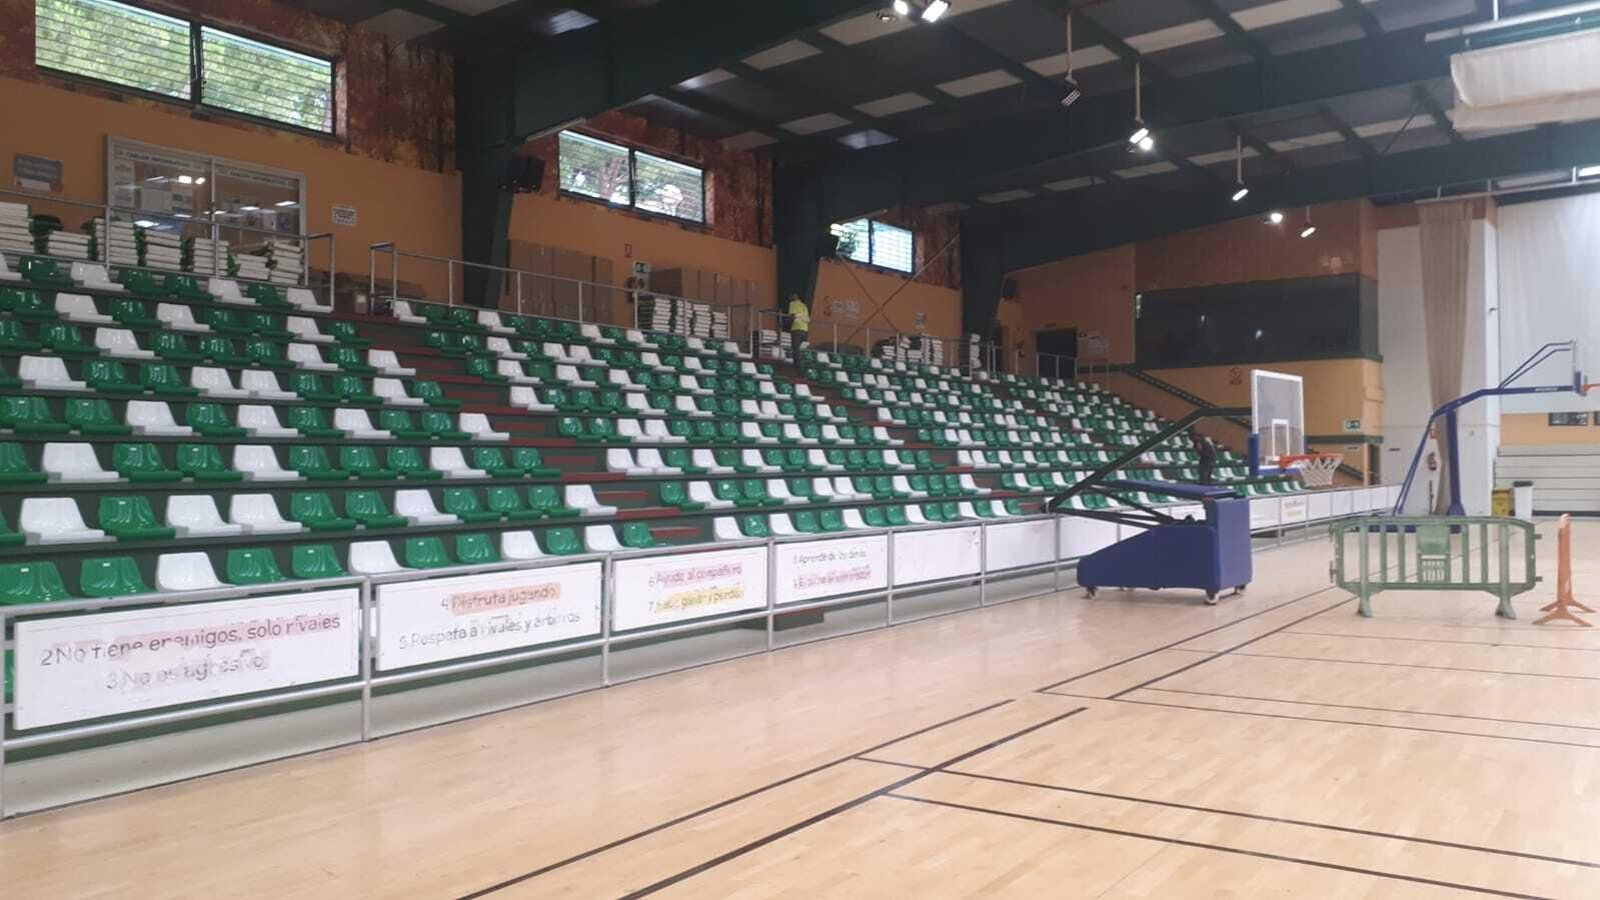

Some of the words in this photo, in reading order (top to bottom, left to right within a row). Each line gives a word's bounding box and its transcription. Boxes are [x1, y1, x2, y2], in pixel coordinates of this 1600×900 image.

[451, 593, 506, 610] Disfruta
[507, 584, 557, 606] jugando
[247, 618, 282, 640] solo
[286, 612, 341, 635] rivales
